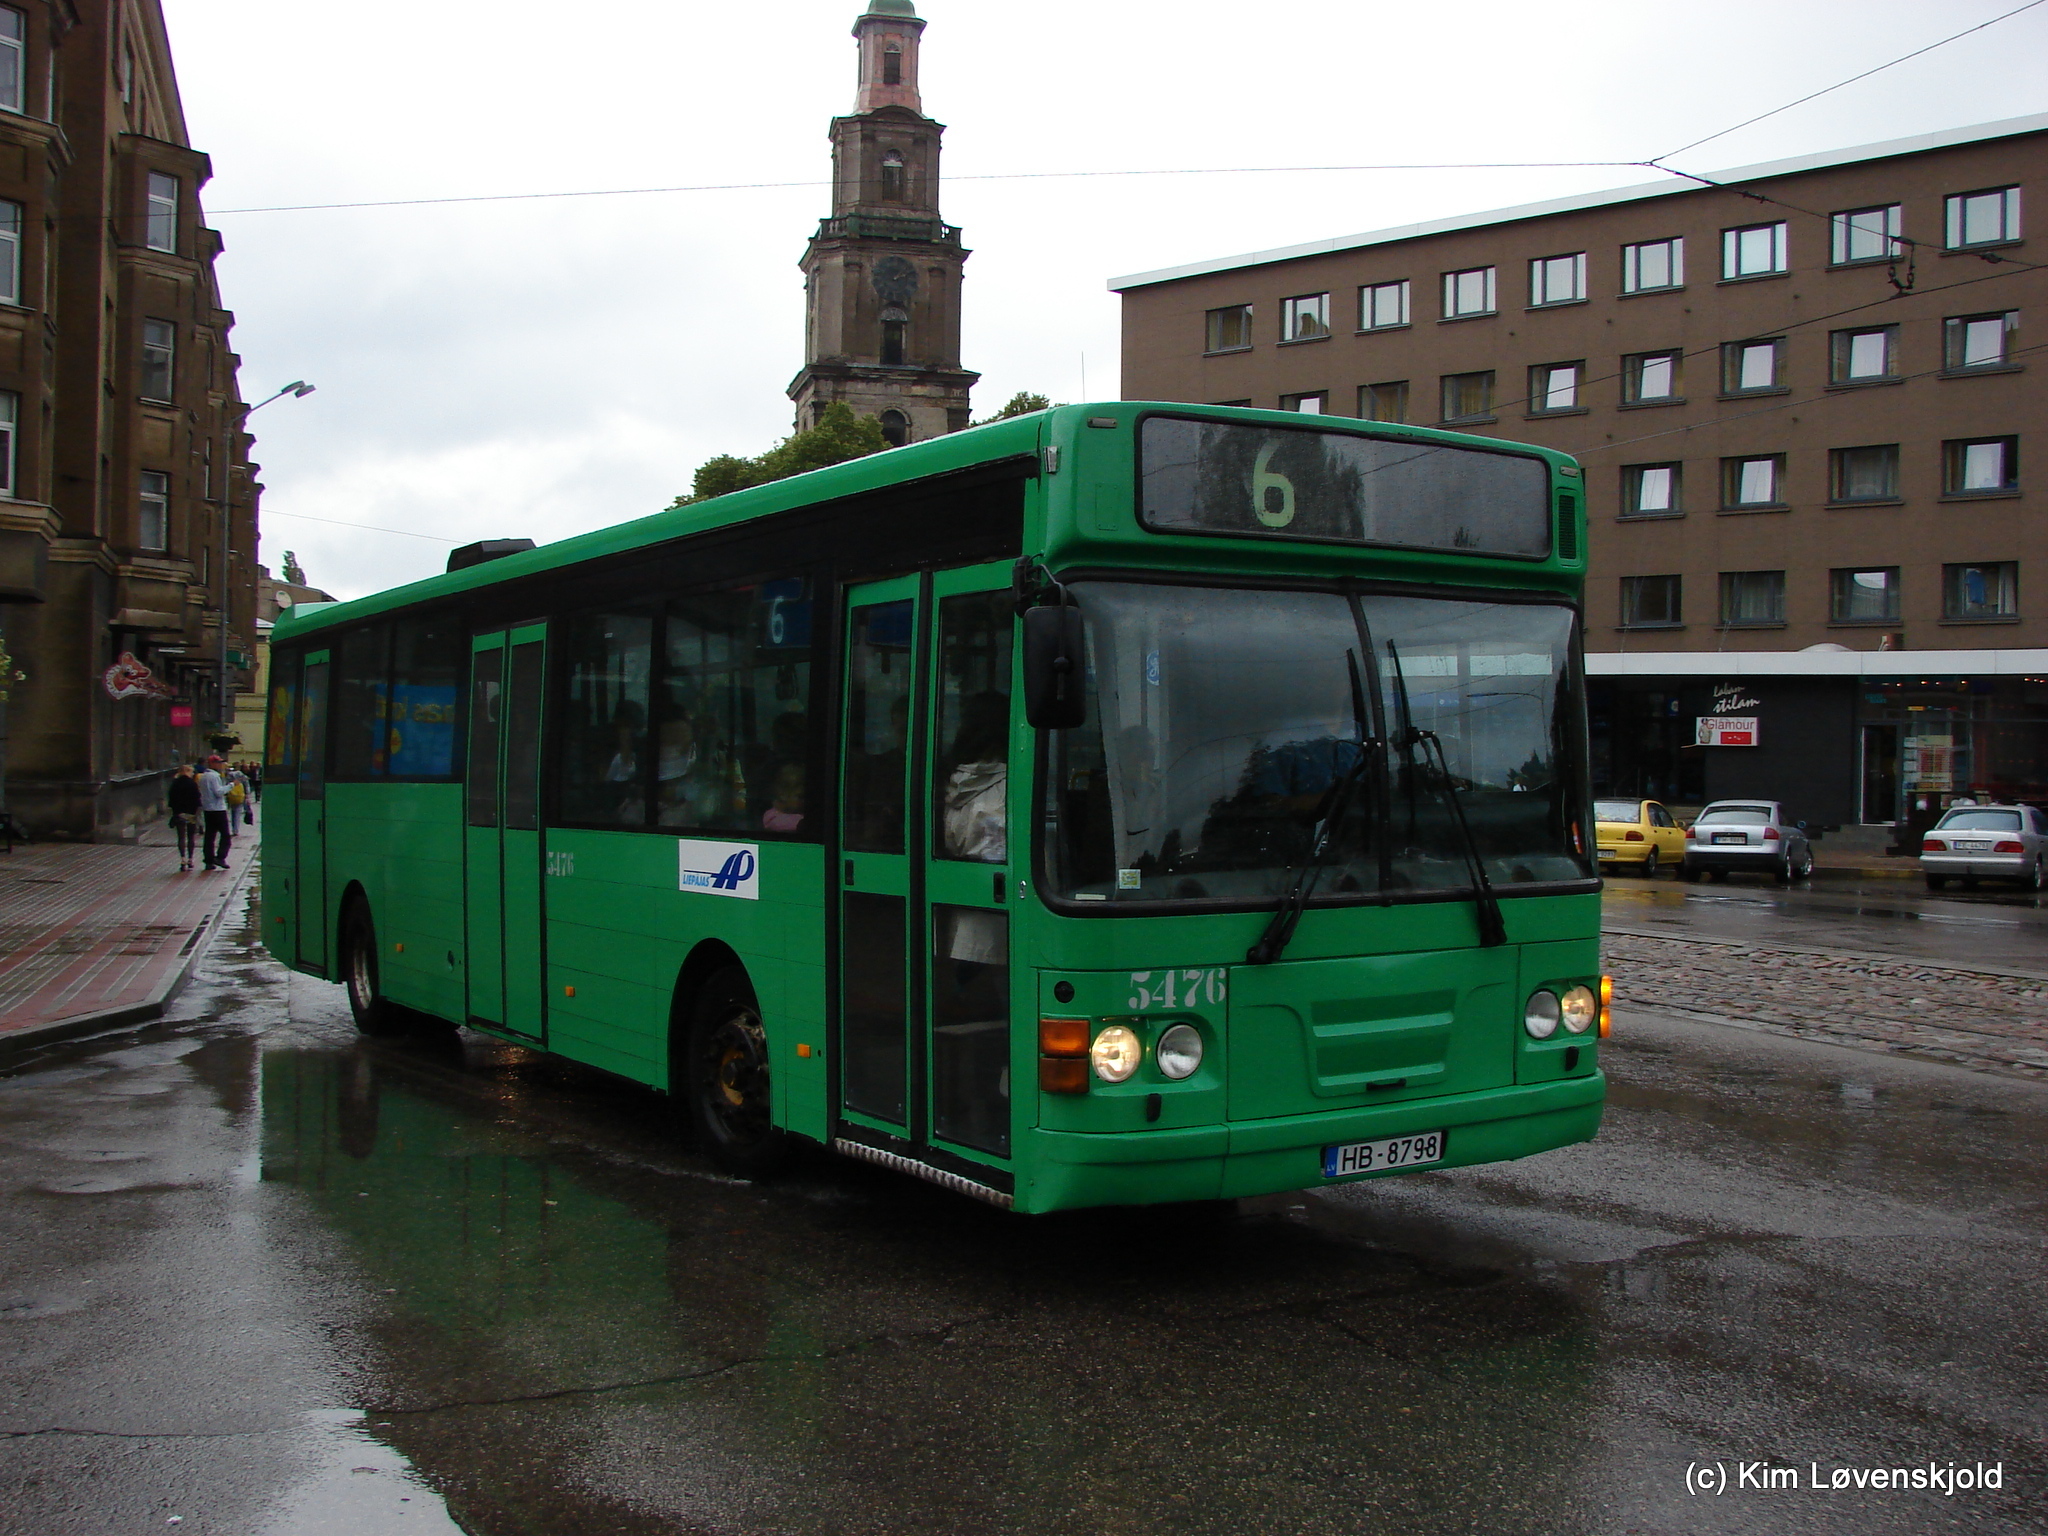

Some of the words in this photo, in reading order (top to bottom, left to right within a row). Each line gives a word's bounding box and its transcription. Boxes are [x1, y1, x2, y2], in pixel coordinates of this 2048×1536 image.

[1253, 437, 1295, 528] 6
[771, 596, 784, 644] 6
[1713, 694, 1760, 713] stilam
[1706, 719, 1755, 730] Glamour
[546, 851, 574, 877] 5476
[1128, 967, 1226, 1010] 5476
[1341, 1135, 1438, 1172] HB-8798
